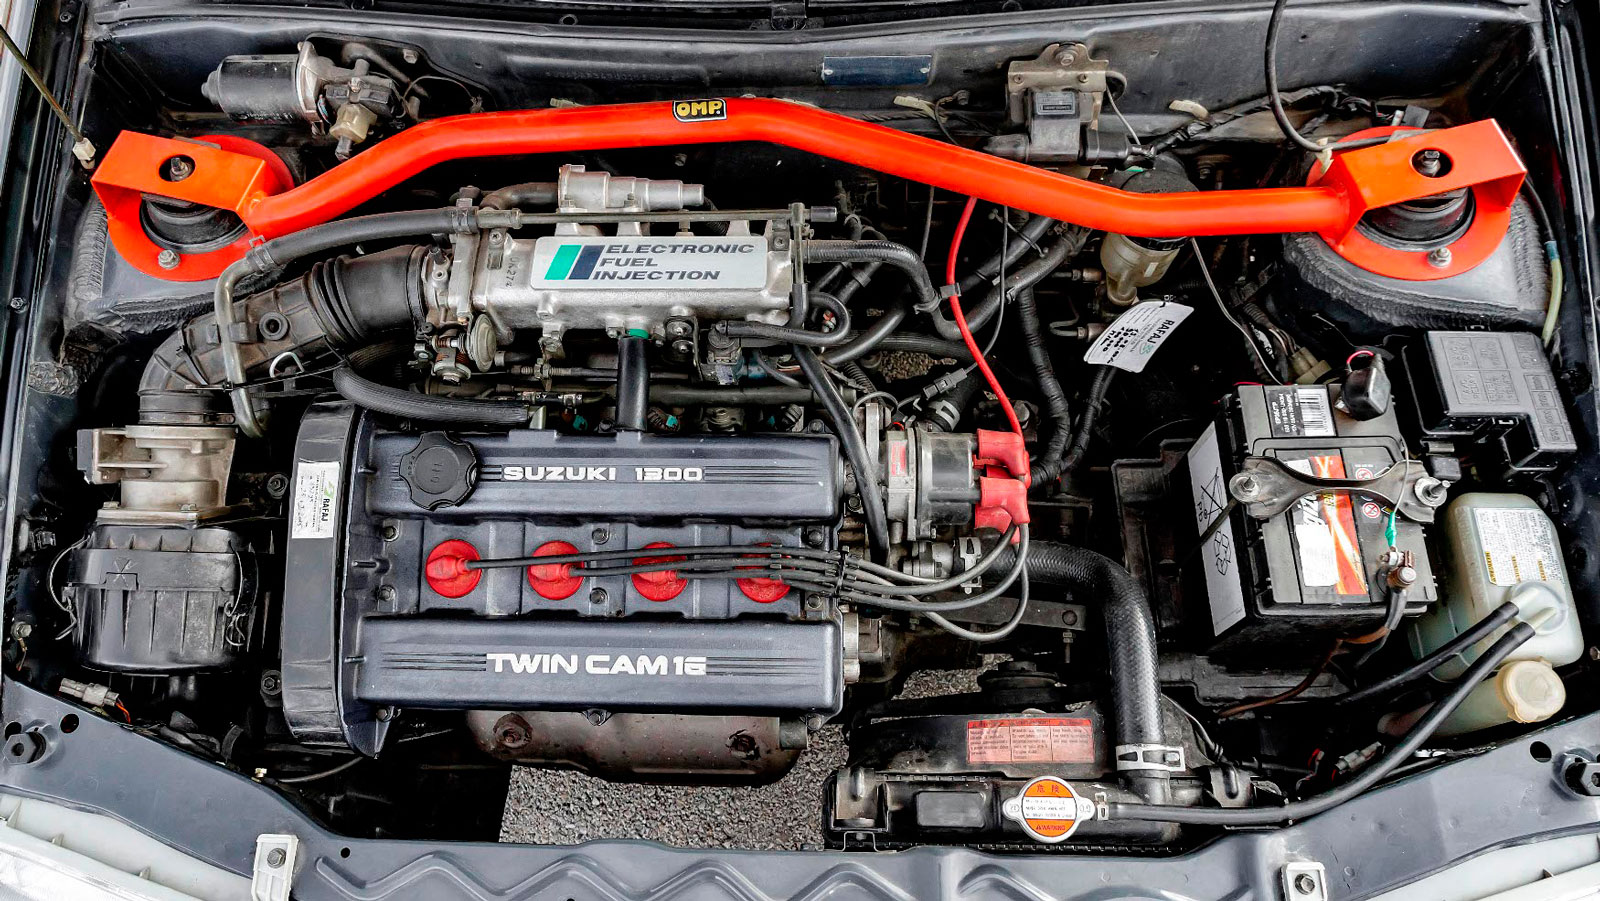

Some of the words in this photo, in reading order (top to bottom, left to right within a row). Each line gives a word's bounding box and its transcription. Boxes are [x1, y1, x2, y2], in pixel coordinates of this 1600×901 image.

[605, 244, 755, 254] ELECTRONIC
[599, 257, 658, 267] FUEL
[592, 270, 720, 280] INJECTION
[1147, 319, 1175, 344] RAFAJ
[503, 466, 616, 481] SUZUKI
[634, 466, 703, 482] 1300
[320, 497, 330, 522] RAFAJ
[486, 653, 578, 674] TWIN
[585, 655, 669, 675] CAM
[673, 656, 707, 676] 16
